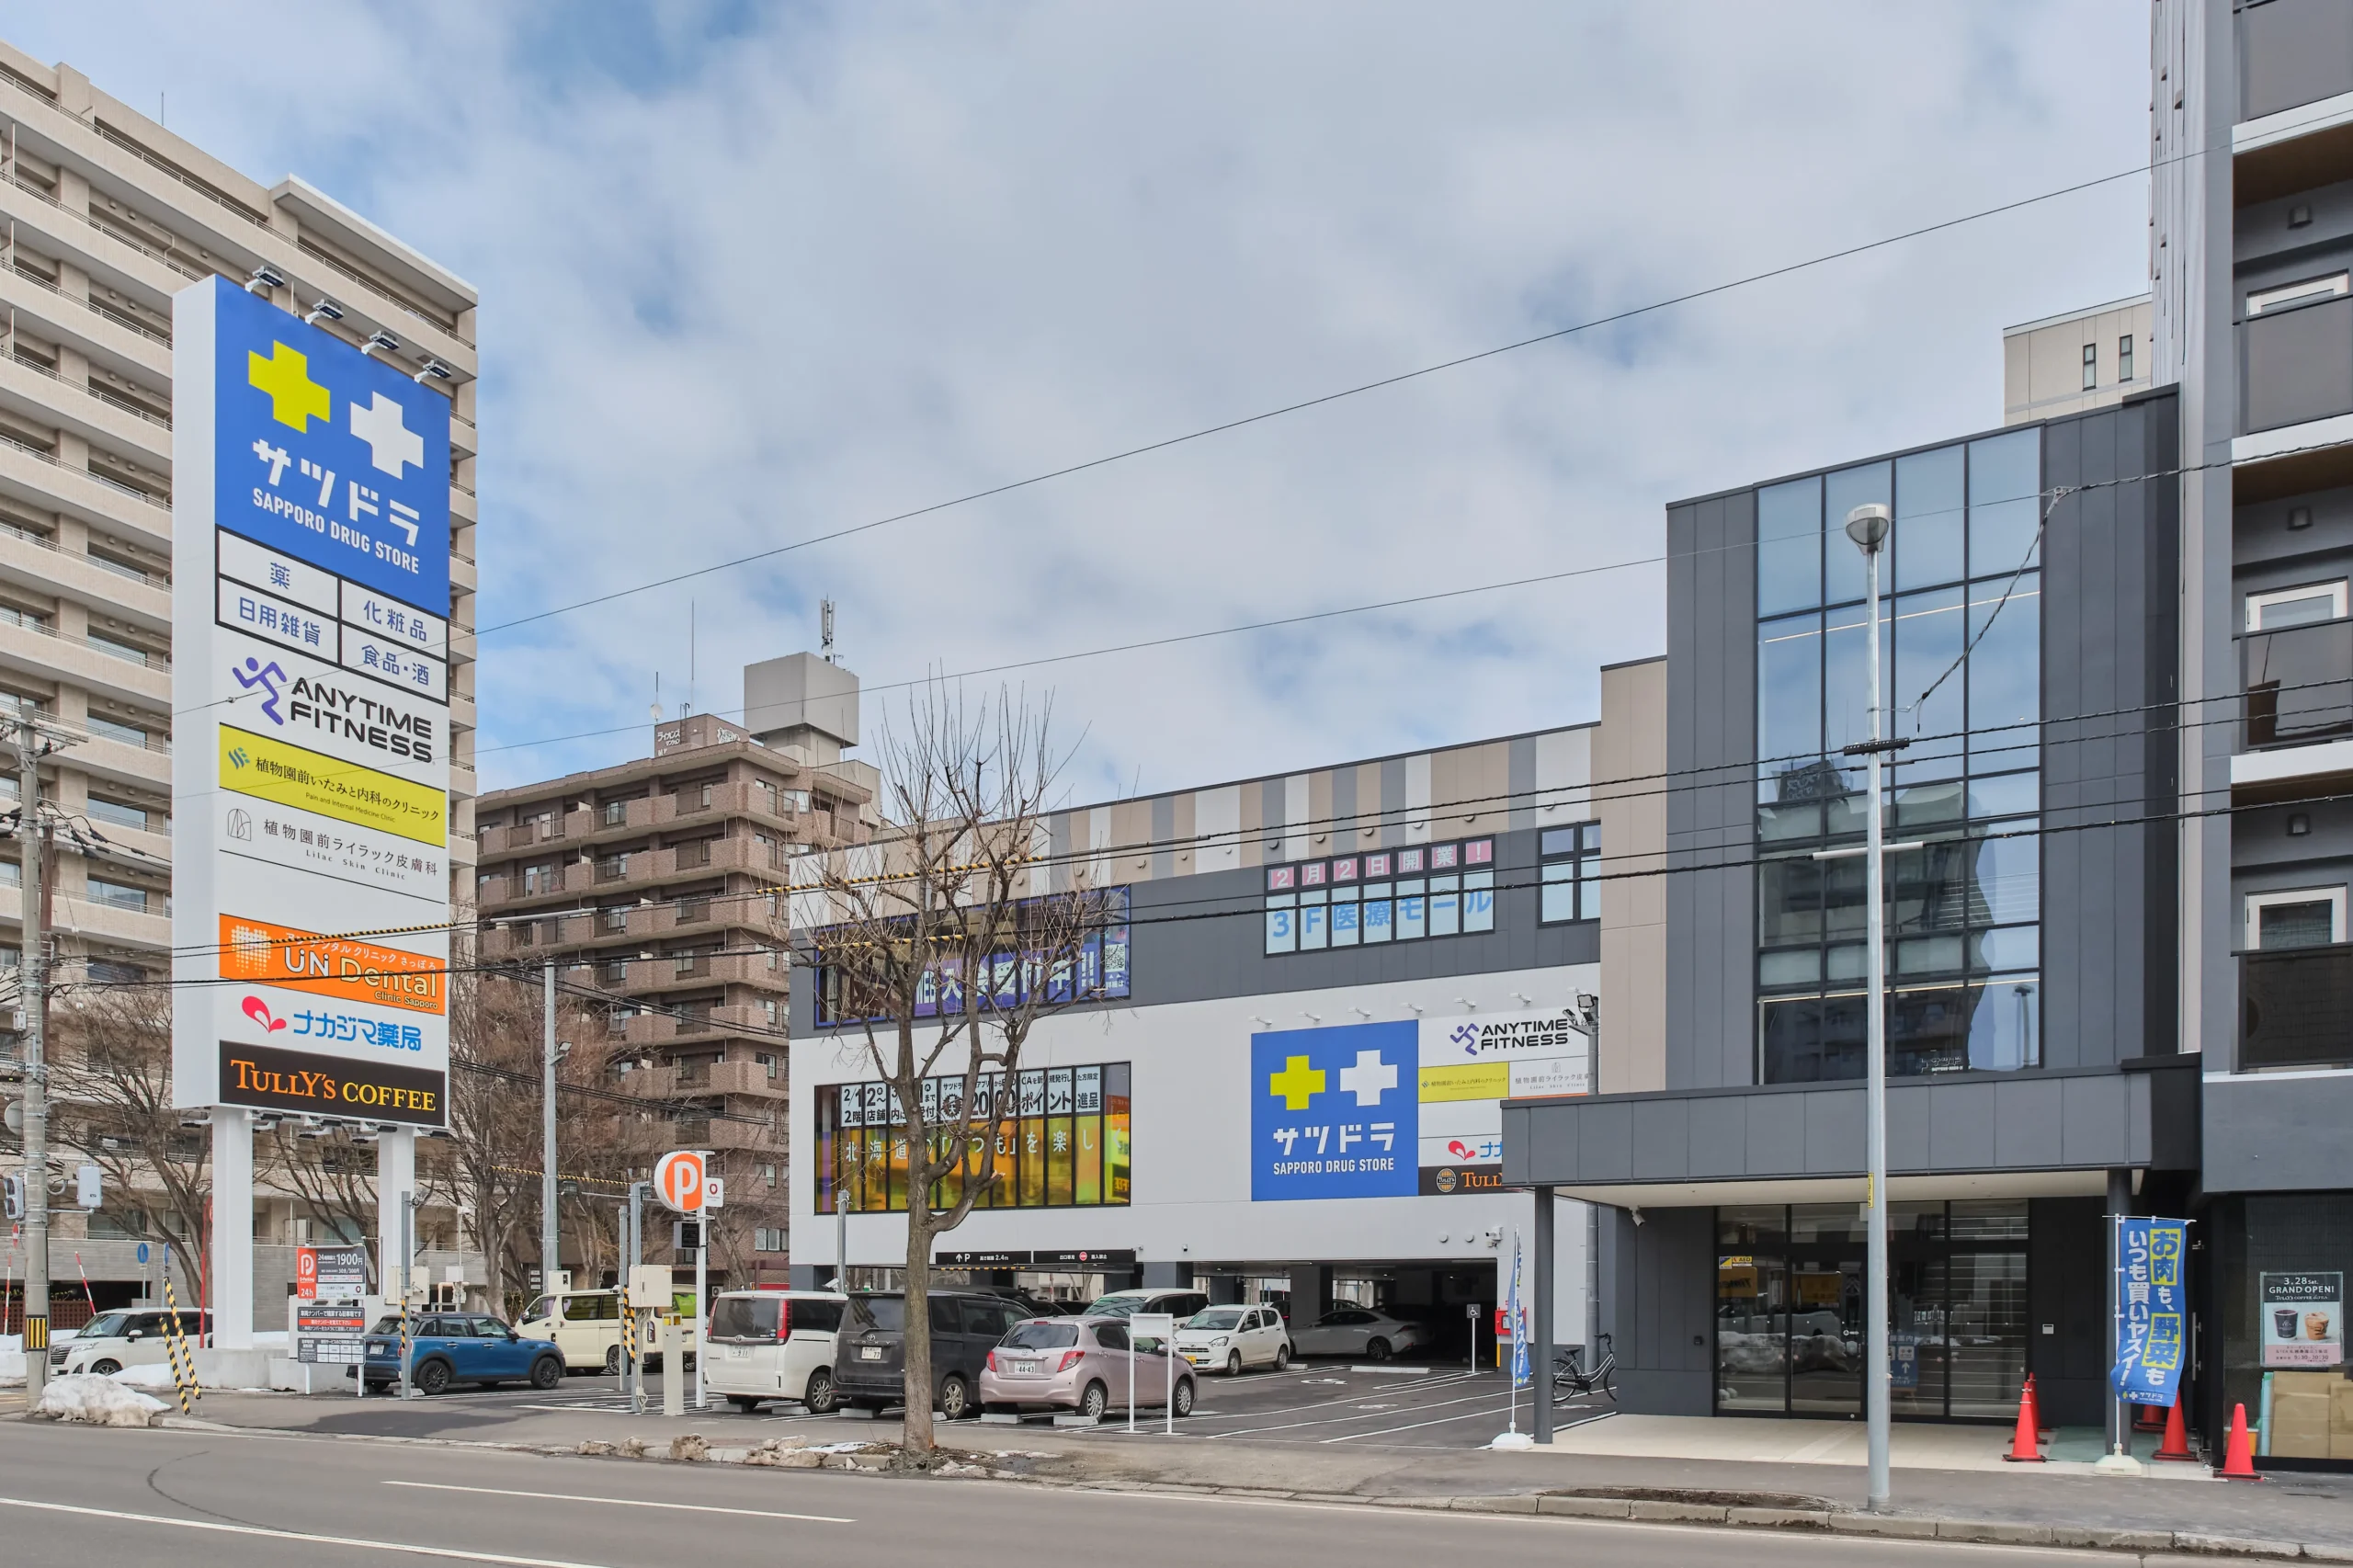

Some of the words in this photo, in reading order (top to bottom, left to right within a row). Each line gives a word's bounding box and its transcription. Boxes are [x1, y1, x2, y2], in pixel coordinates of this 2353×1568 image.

[253, 438, 420, 547] サツドラ
[253, 488, 325, 533] SAPPORO
[330, 520, 370, 553] DRUG
[375, 540, 420, 574] STORE
[270, 562, 290, 589] 薬
[239, 597, 321, 647] 日用雑貨
[363, 599, 427, 642] 化粧品
[361, 644, 429, 686] 食品・酒
[290, 676, 432, 740] ANYTIME
[290, 700, 432, 764] FITNESS
[256, 756, 439, 822] 植物園前いたみと内科のクリニック
[305, 792, 319, 801] Pain
[319, 795, 331, 805] and
[332, 798, 355, 812] Internal
[355, 804, 380, 819] Medicine
[380, 812, 396, 823] Clinic
[263, 818, 438, 877] 植物園前ライラック皮膚科
[306, 849, 334, 862] Lilac
[343, 858, 366, 870] Skin
[375, 867, 406, 881] Clinic
[1276, 842, 1483, 889] 2月2日開業!
[1272, 891, 1494, 938] 3F医療モール
[340, 957, 437, 998] Dental
[374, 991, 402, 1004] Clinic
[404, 995, 438, 1010] Sapporo
[293, 1009, 422, 1051] ナカジマ薬局
[1481, 1018, 1568, 1038] ANYTIME
[1481, 1033, 1569, 1051] FITNESS
[342, 1082, 437, 1112] COFFEE
[1273, 1121, 1394, 1155] サツドラ
[674, 1161, 699, 1210] P
[1273, 1161, 1323, 1176] SAPPORO
[1326, 1159, 1356, 1173] DRUG
[1359, 1157, 1394, 1171] STORE
[336, 1253, 363, 1266] 1900円
[964, 1253, 971, 1262] P
[301, 1288, 313, 1298] 24h
[2268, 1286, 2302, 1294] GRAND
[2304, 1285, 2335, 1293] OPEN!
[2283, 1277, 2307, 1285] 3.28
[2118, 1230, 2151, 1386] いつも買いヤスイ!
